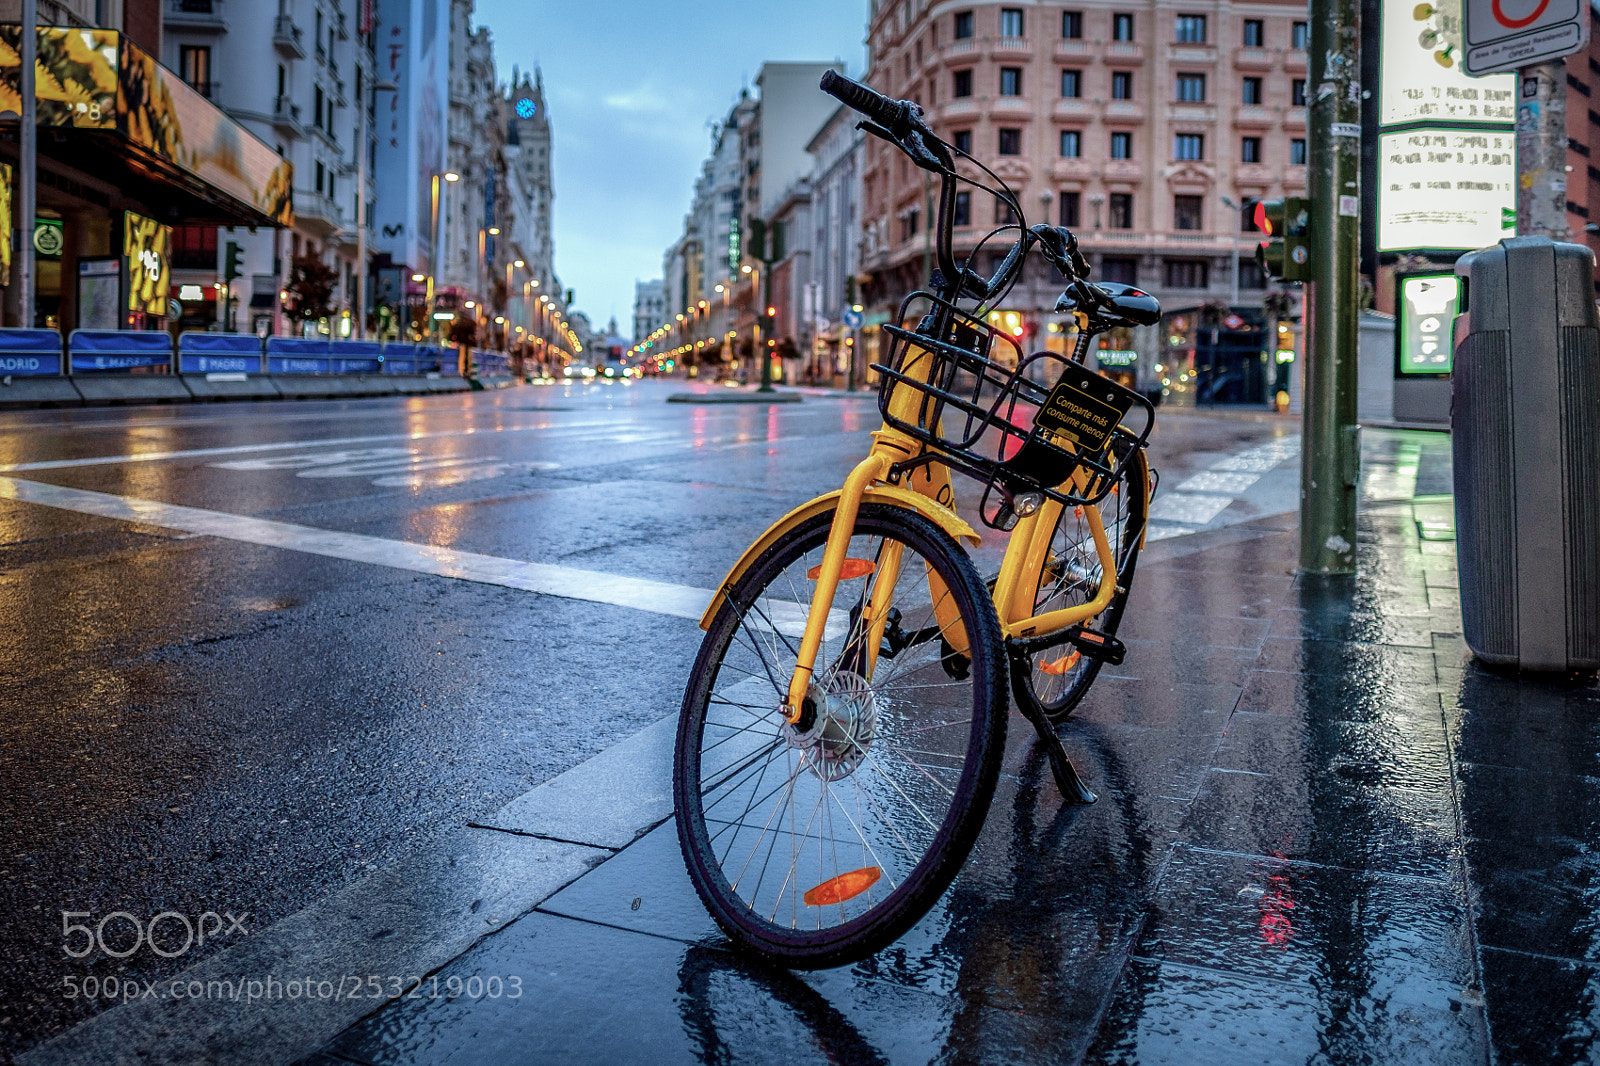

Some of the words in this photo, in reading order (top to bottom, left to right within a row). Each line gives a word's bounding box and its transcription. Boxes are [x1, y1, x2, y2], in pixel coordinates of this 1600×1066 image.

[210, 358, 246, 371] MADRID
[1046, 407, 1080, 428] consume
[1079, 423, 1106, 440] menos
[1056, 395, 1092, 419] Comparte
[1091, 414, 1108, 427] más
